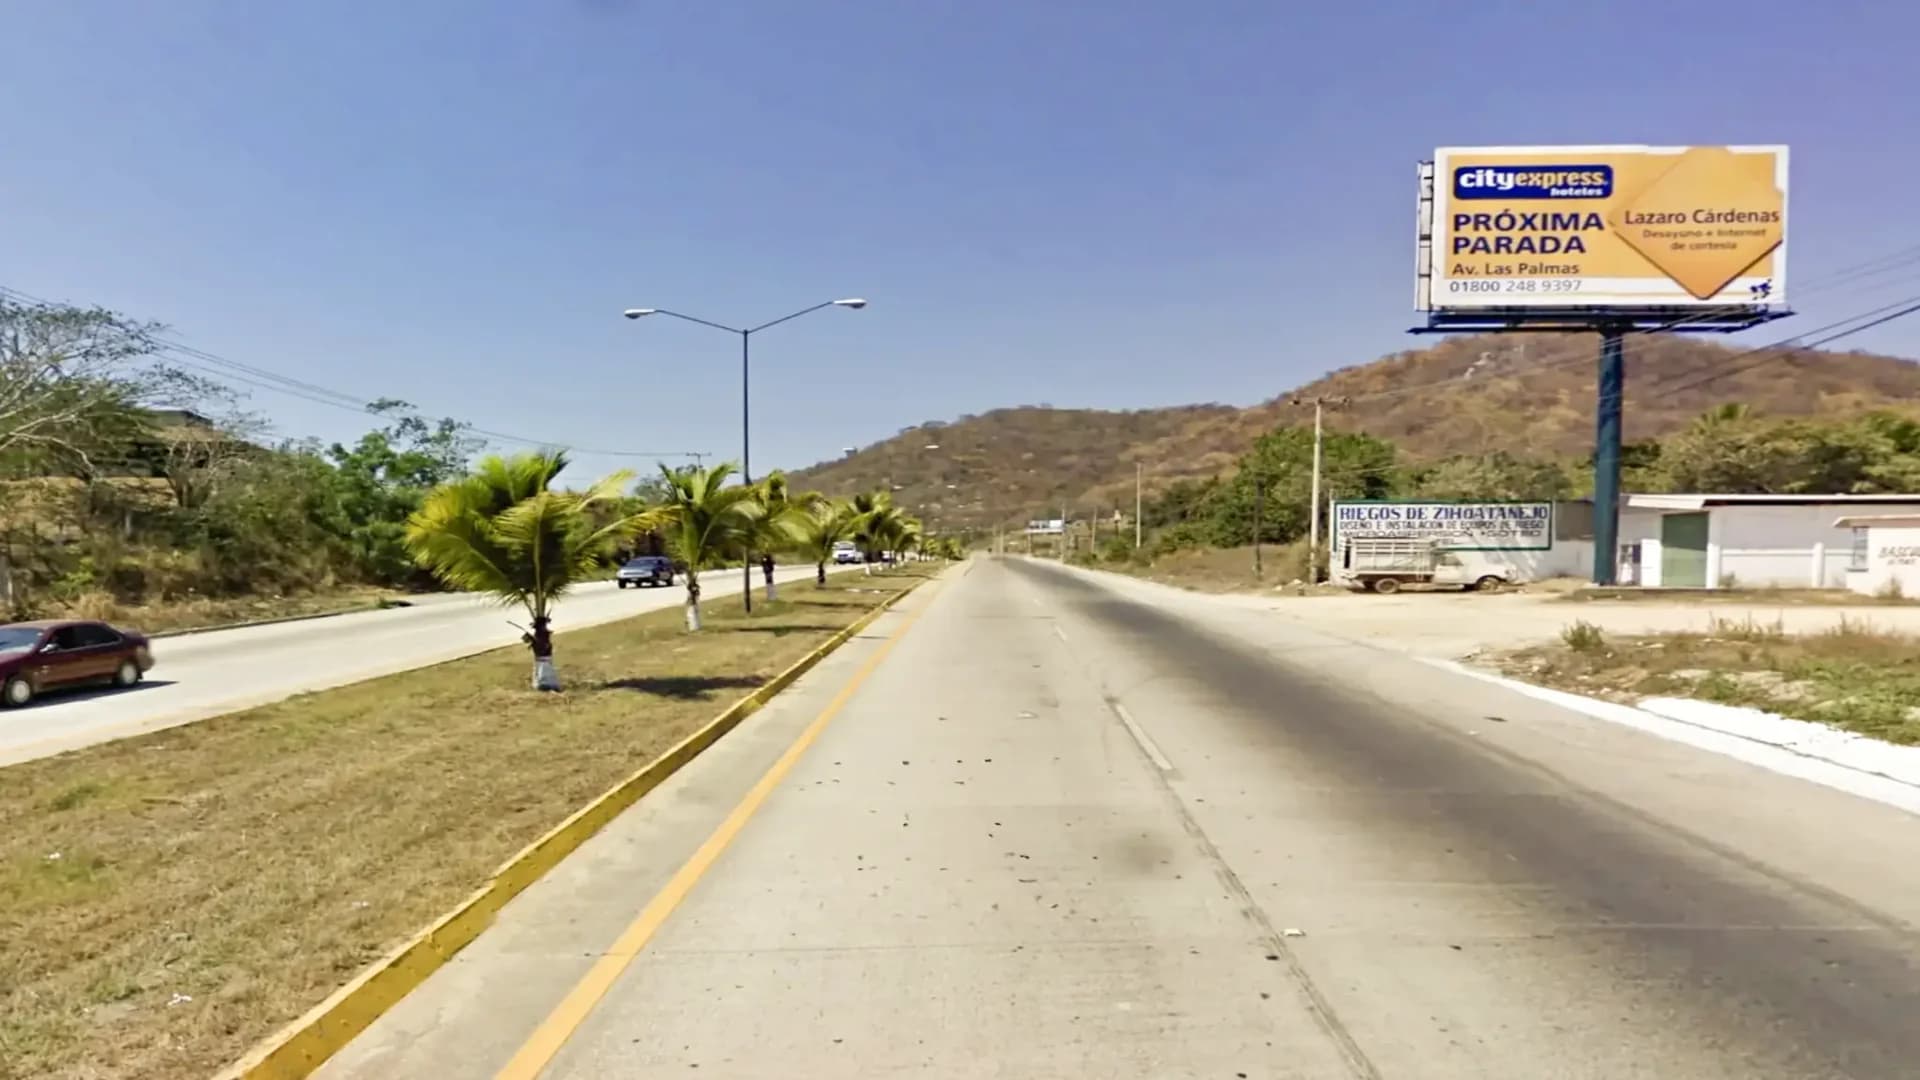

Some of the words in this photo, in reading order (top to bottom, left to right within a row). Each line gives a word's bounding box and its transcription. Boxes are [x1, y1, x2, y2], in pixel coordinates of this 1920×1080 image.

[1550, 187, 1603, 197] hoteles
[1453, 208, 1605, 231] PRÓXIMA
[1624, 210, 1687, 225] Lazaro
[1692, 208, 1780, 224] Cárdenas
[1453, 236, 1586, 255] PARADA
[1670, 241, 1685, 250] de
[1452, 263, 1479, 276] Av.
[1485, 262, 1512, 275] Las
[1518, 262, 1580, 275] Palmas
[1450, 281, 1500, 293] 01800
[1505, 280, 1536, 292] 248
[1542, 279, 1582, 292] 9397
[1340, 507, 1401, 520] RIEGOS
[1407, 507, 1428, 519] DE
